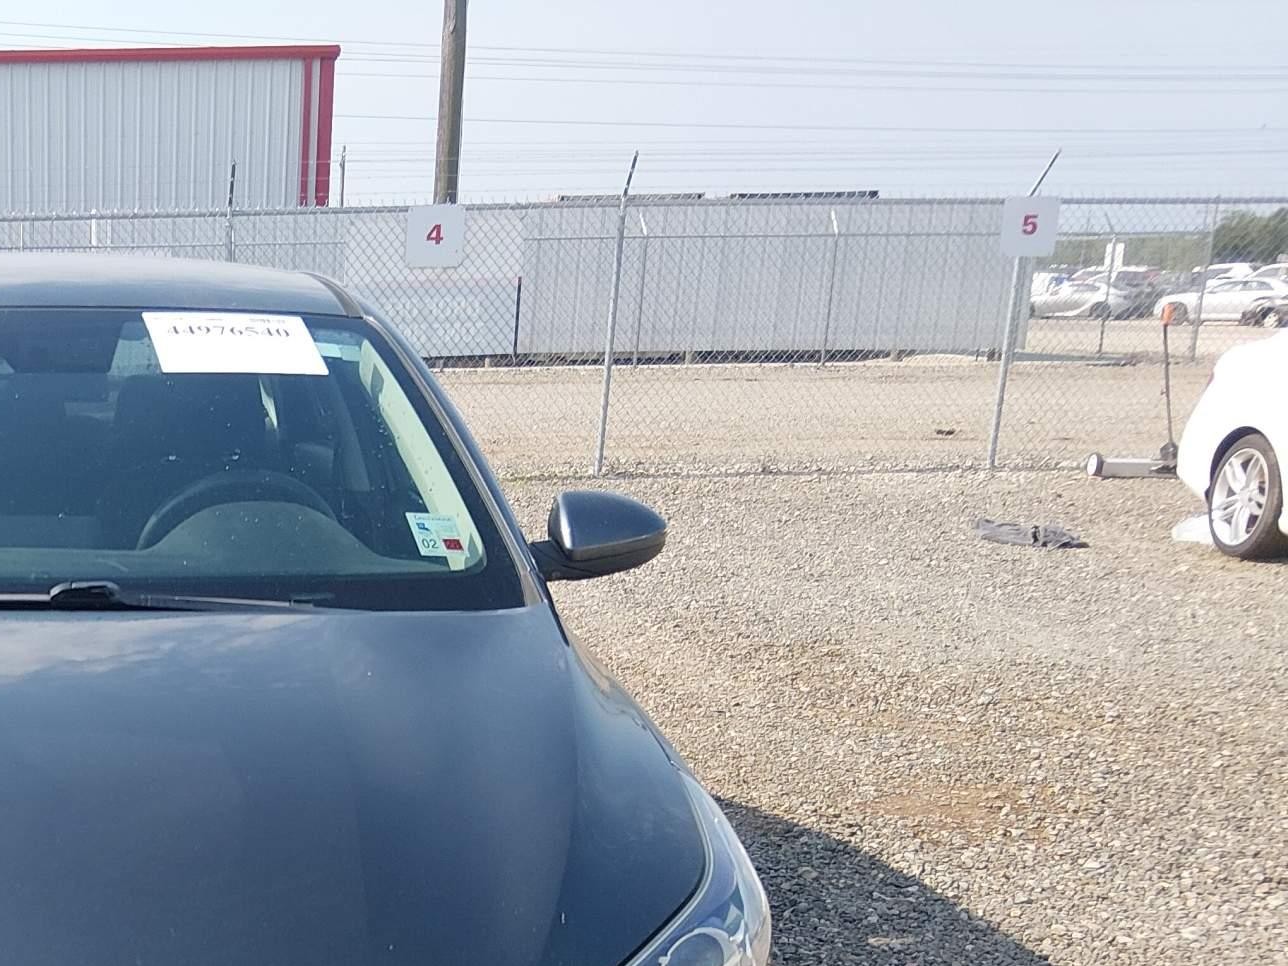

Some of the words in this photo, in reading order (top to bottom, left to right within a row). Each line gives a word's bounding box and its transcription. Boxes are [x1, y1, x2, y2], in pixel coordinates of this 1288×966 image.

[426, 223, 444, 246] 4
[1022, 214, 1039, 236] 5
[421, 538, 440, 549] 02
